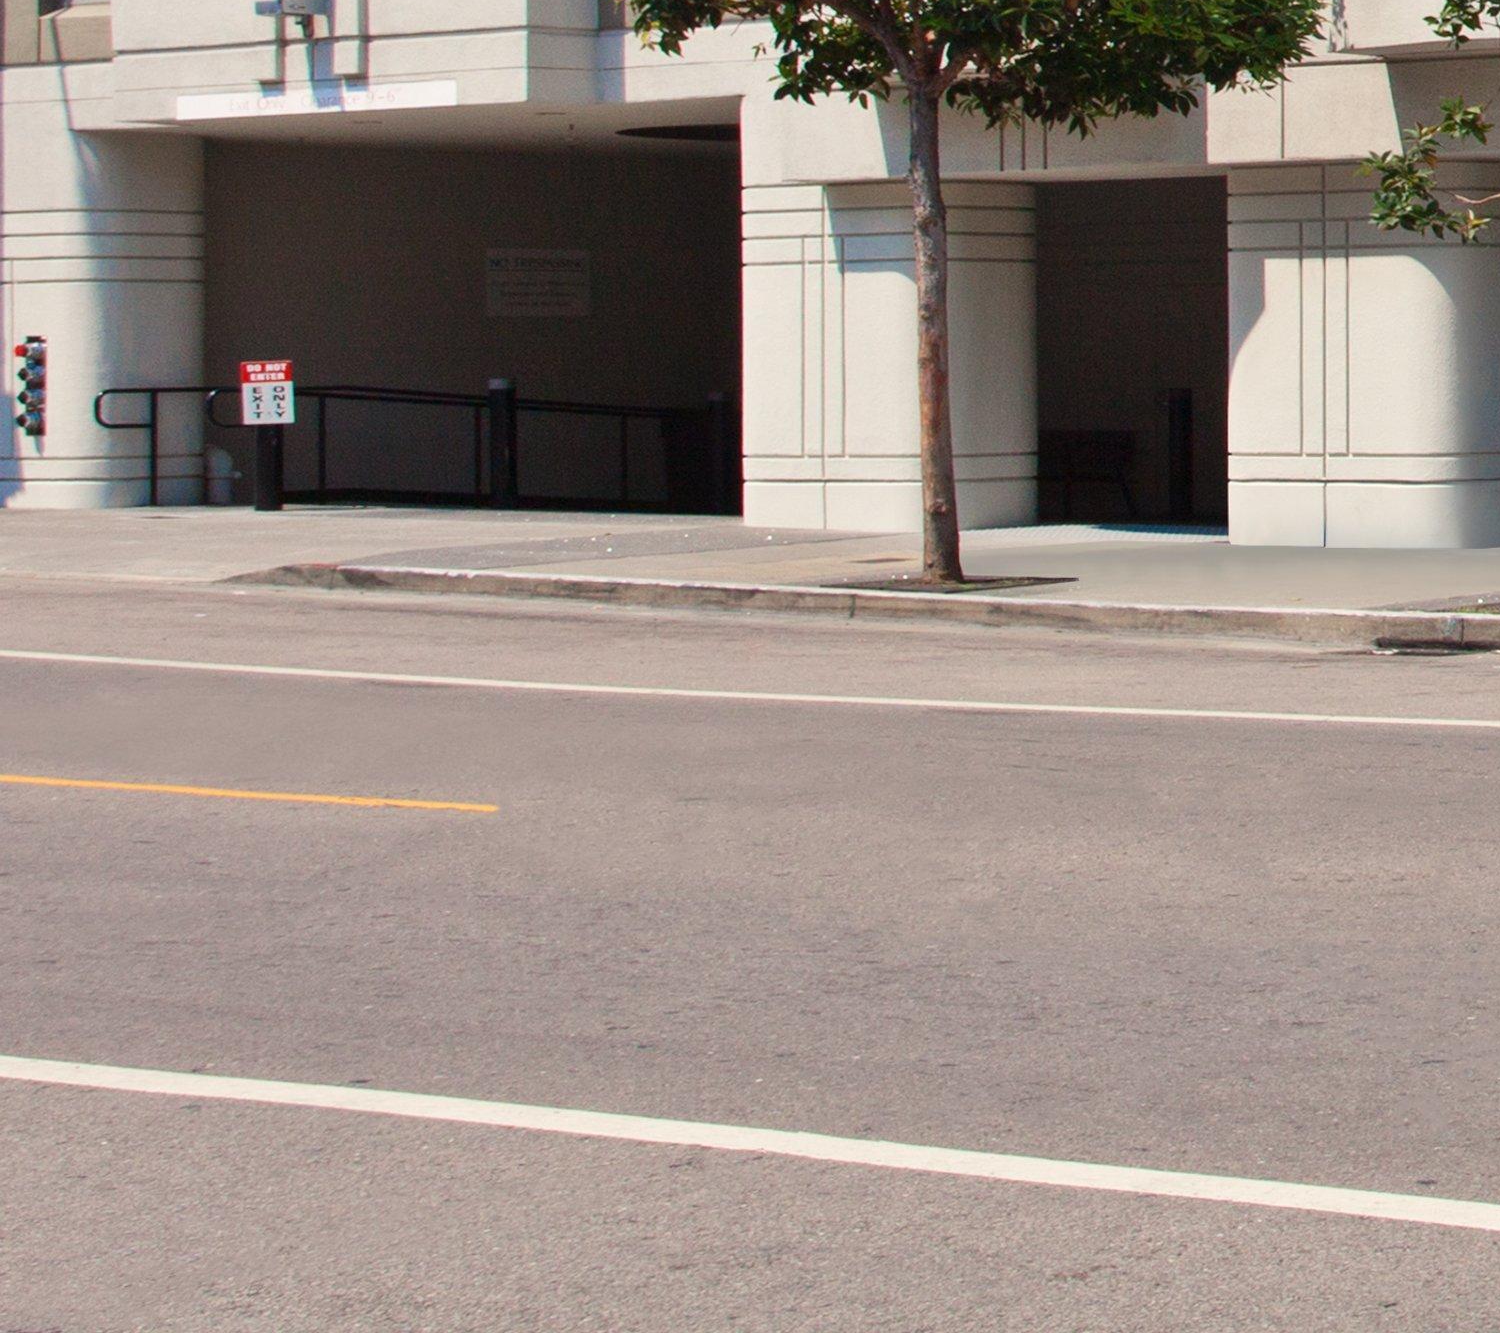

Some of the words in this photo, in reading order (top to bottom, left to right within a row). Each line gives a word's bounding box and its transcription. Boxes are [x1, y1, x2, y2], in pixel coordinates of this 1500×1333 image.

[246, 364, 261, 372] DO
[265, 362, 287, 371] NOT
[250, 372, 285, 381] ENTER
[252, 386, 263, 419] EXIT
